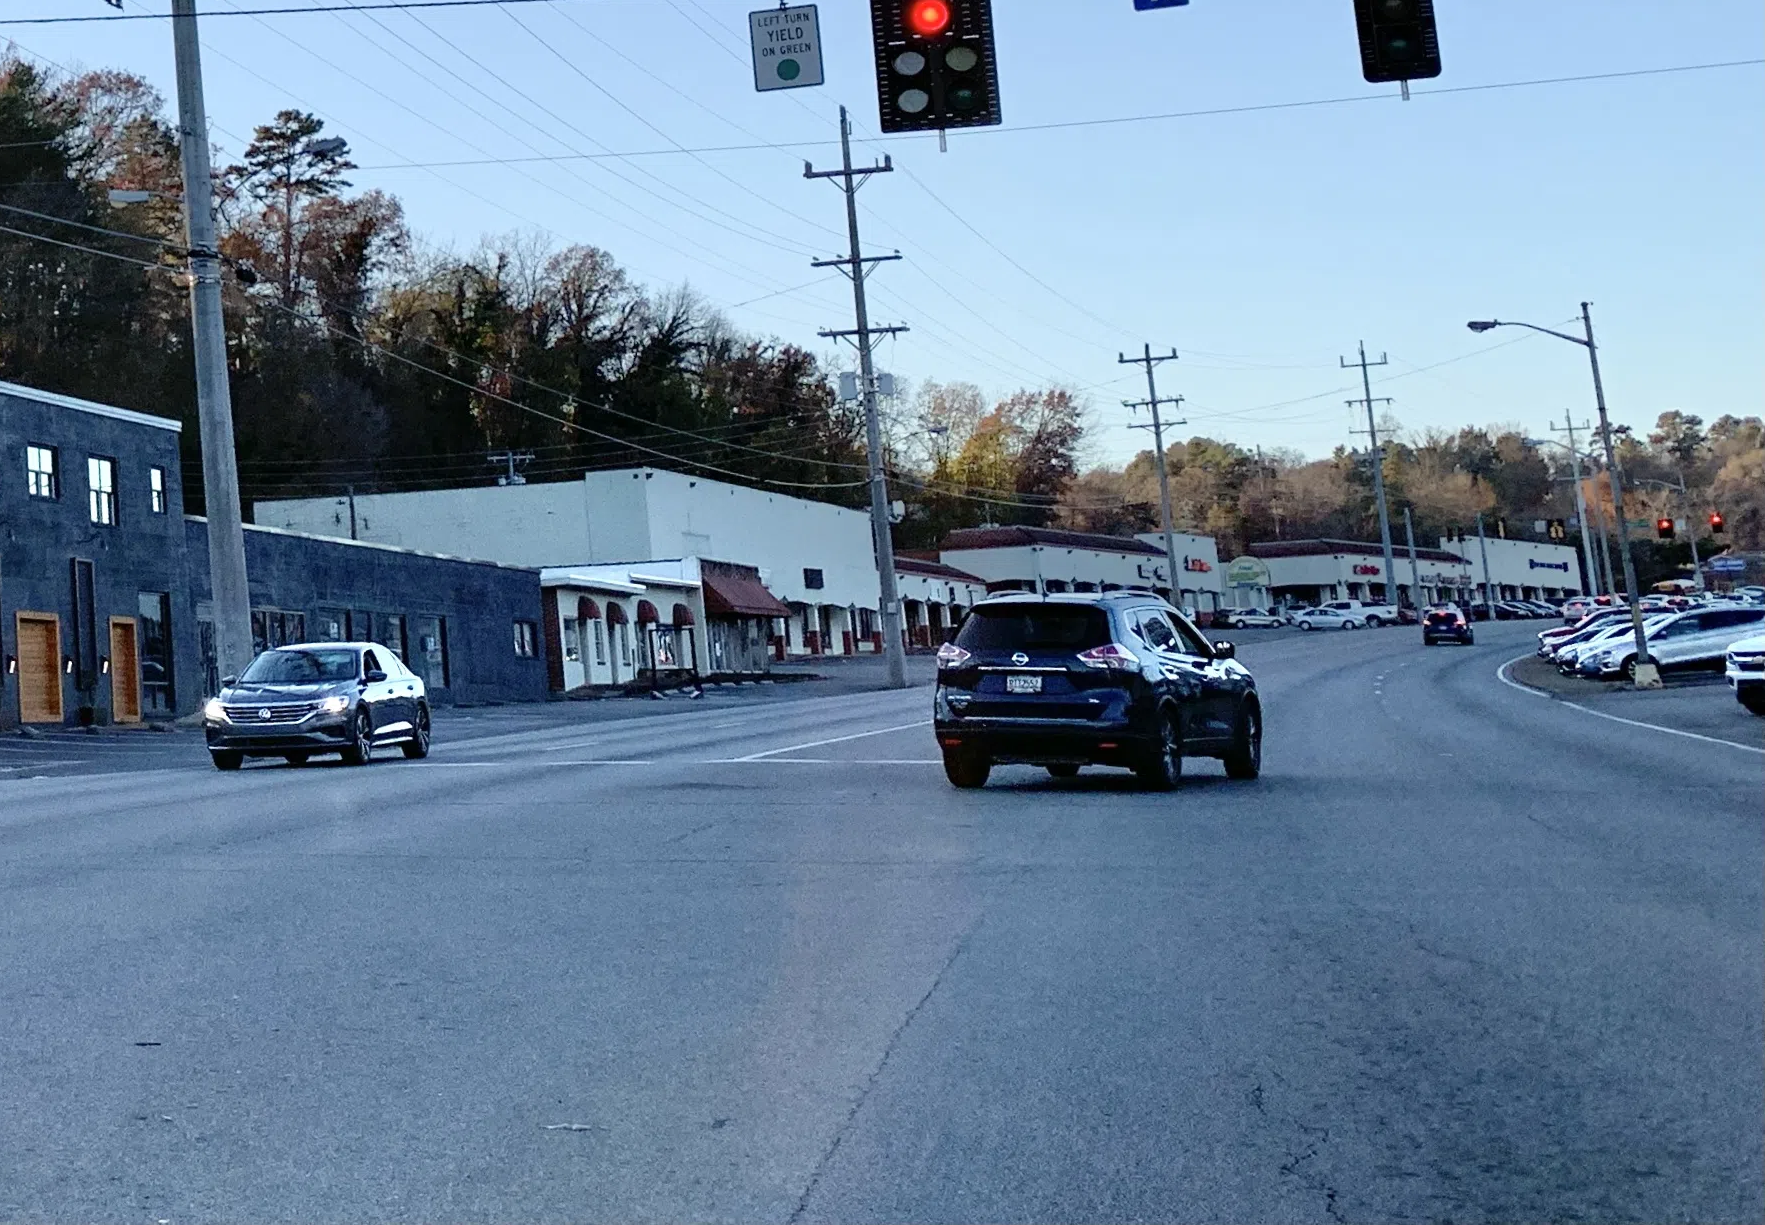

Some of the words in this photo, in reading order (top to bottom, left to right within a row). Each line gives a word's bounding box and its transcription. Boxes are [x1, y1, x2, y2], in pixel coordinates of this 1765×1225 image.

[758, 15, 779, 28] LEFT
[785, 13, 810, 24] TURN
[767, 27, 803, 42] YIELD
[762, 47, 775, 57] ON
[780, 43, 811, 54] GREEN
